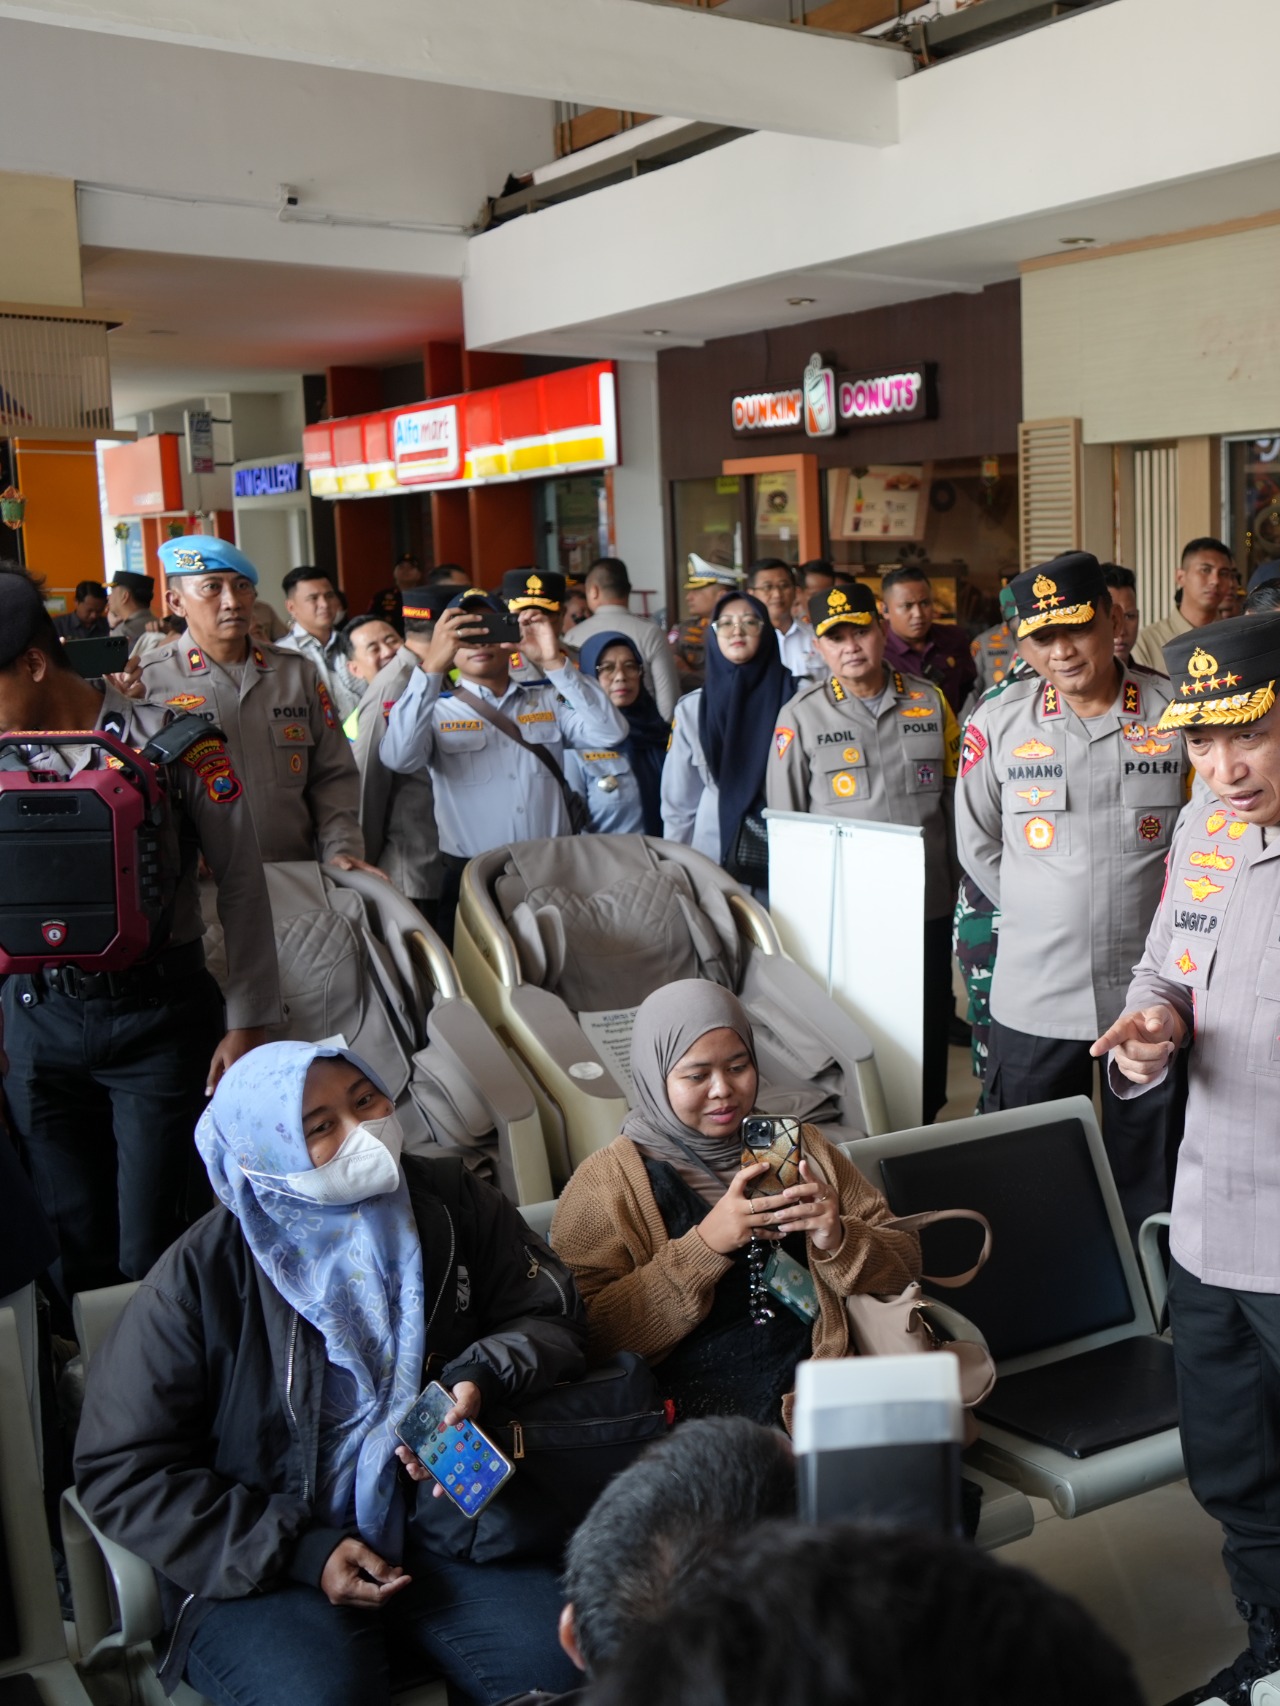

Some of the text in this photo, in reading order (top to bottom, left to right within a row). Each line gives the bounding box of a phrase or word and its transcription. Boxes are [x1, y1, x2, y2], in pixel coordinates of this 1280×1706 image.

[397, 414, 450, 445] Alfamart
[254, 461, 298, 495] GALLERY
[273, 707, 307, 718] POLRI
[903, 722, 938, 734] POLRI
[817, 731, 856, 745] FADIL
[1007, 763, 1064, 780] NANANG
[1124, 761, 1179, 775] POLRI
